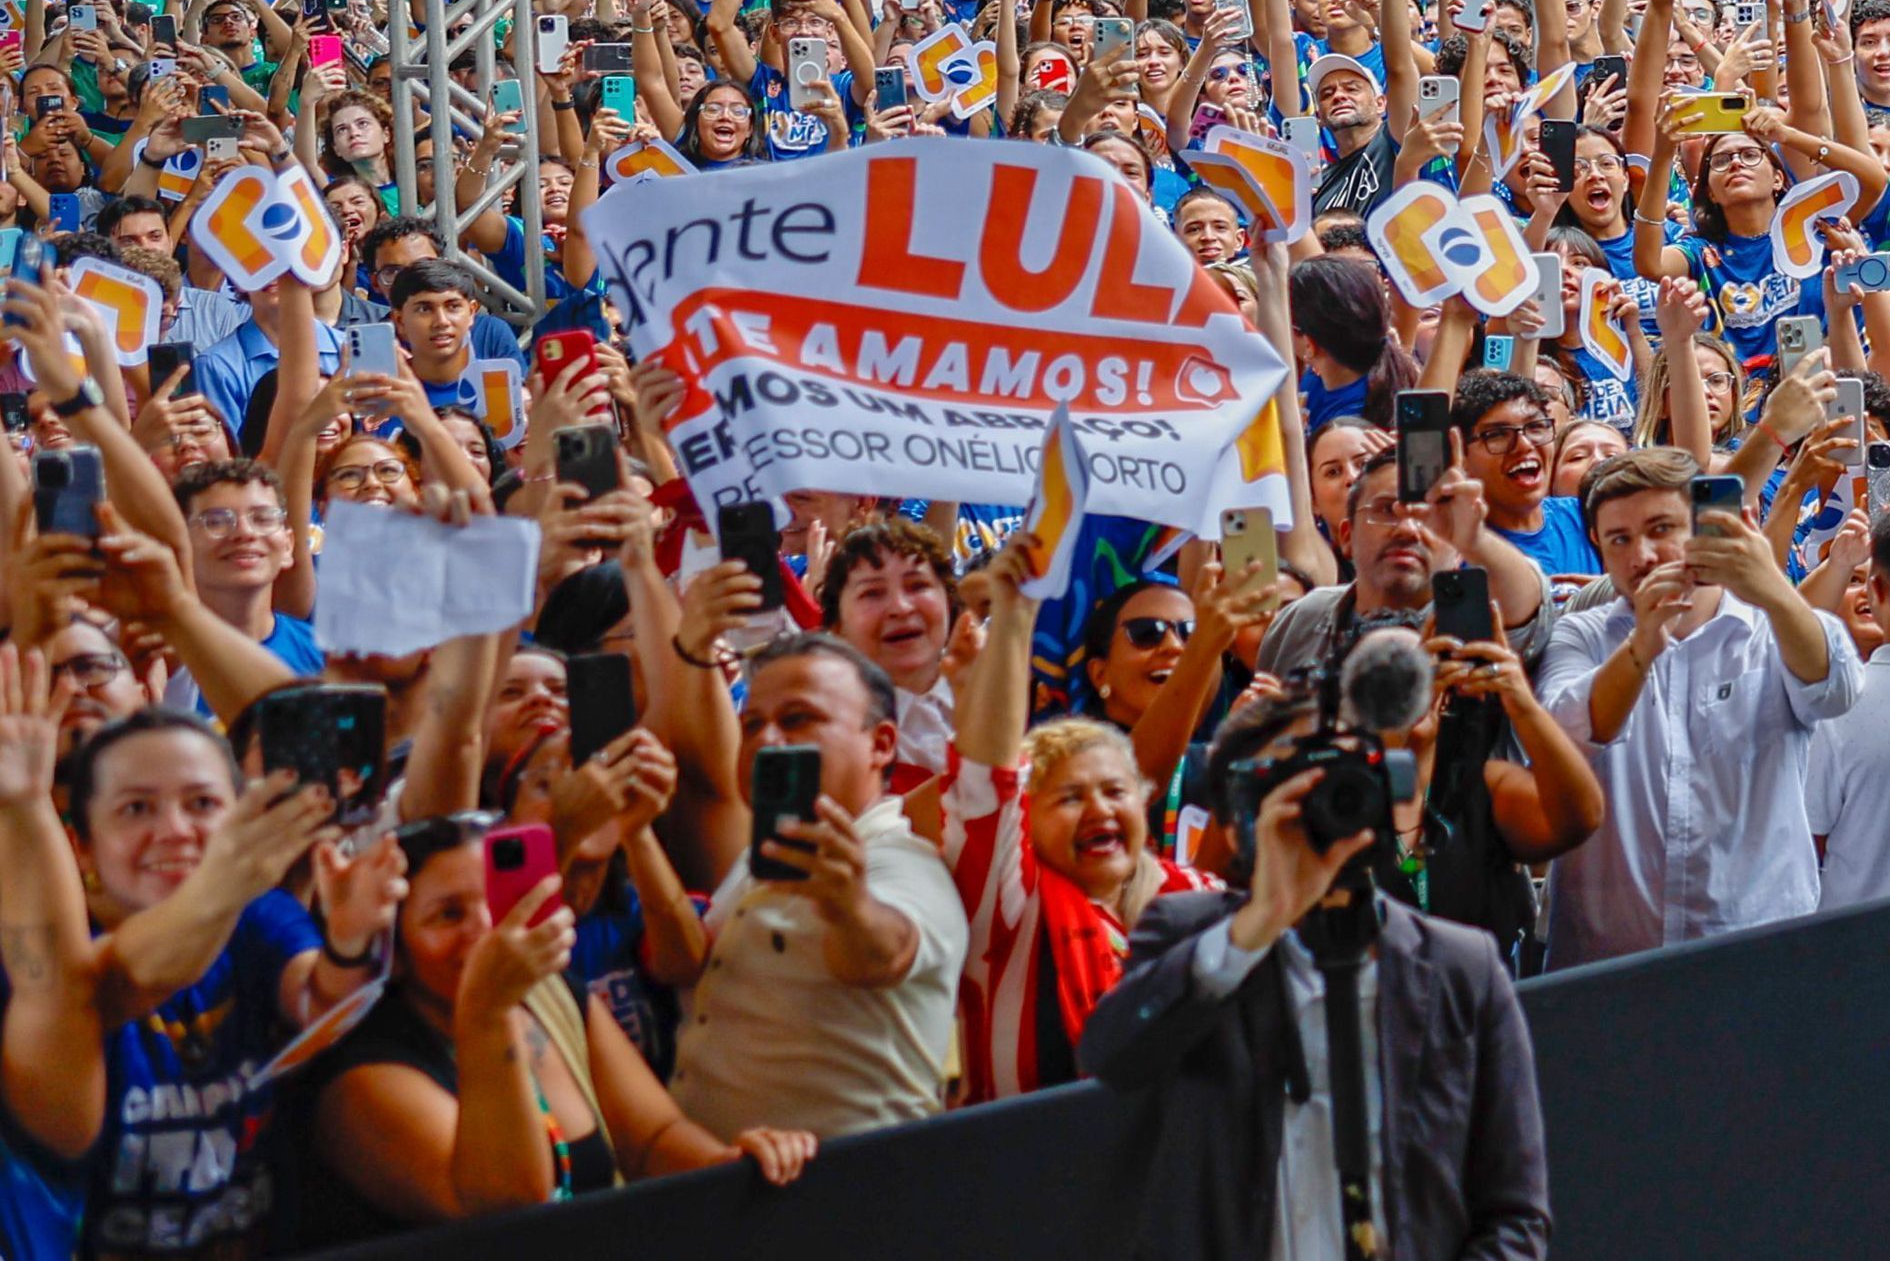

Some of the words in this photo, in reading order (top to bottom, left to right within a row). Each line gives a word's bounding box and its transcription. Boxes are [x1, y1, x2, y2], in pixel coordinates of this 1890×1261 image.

[602, 197, 836, 336] dente
[685, 303, 780, 358] TE
[800, 321, 1155, 407] AMAMOS!
[841, 388, 934, 427] UM
[1088, 451, 1187, 496] ORTO
